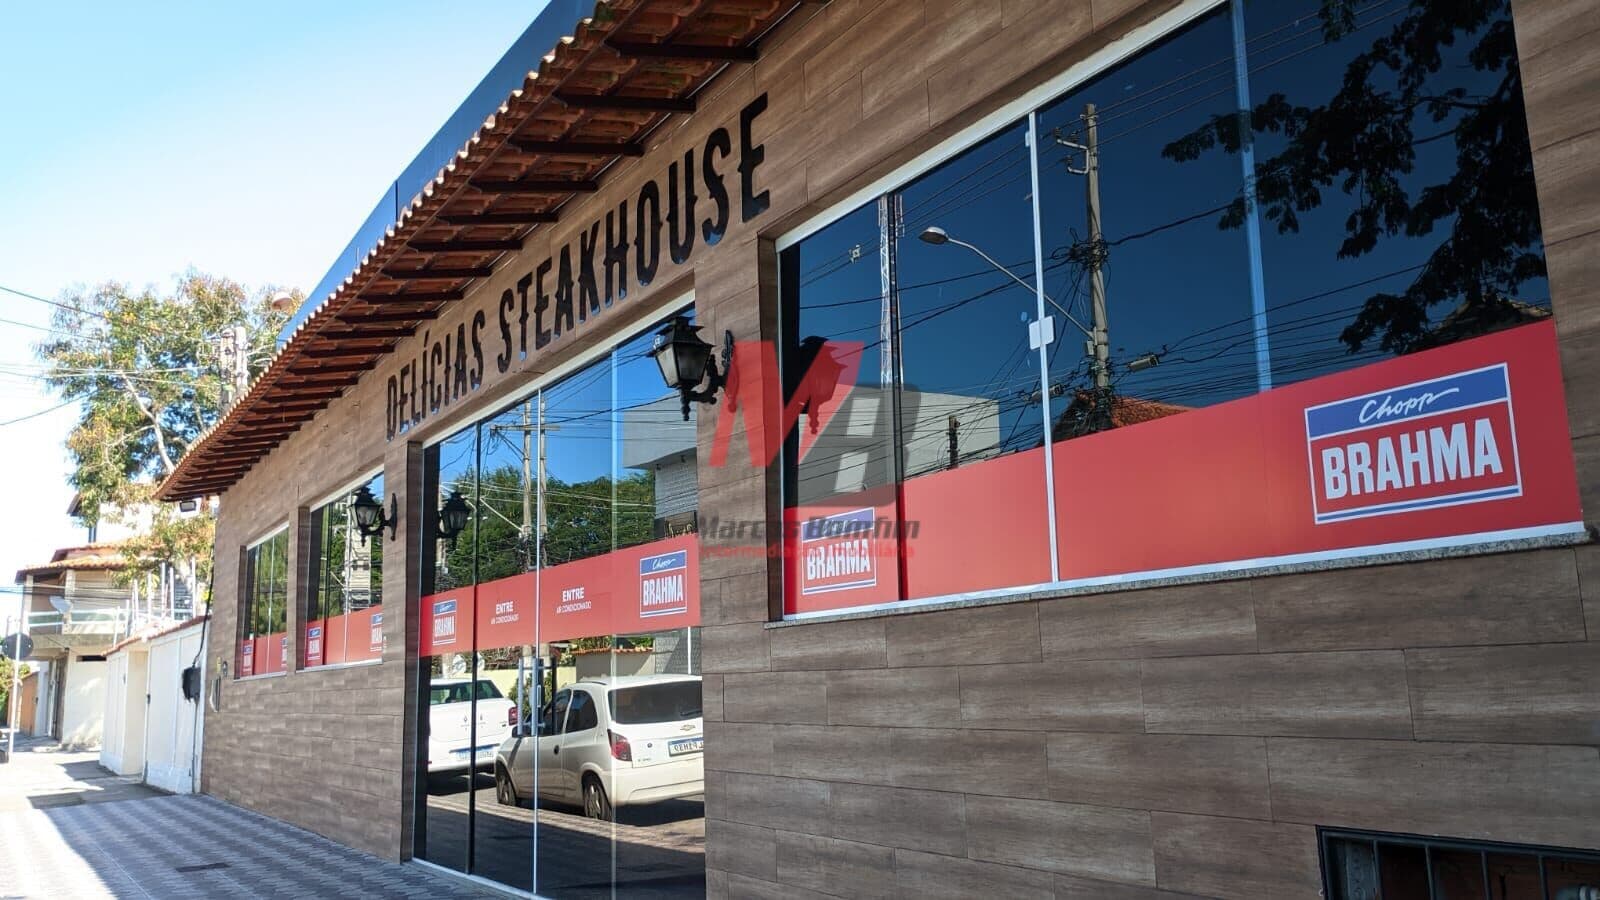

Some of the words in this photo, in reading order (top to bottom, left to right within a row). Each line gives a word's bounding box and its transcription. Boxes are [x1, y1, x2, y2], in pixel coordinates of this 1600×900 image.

[386, 310, 486, 442] DELÍCIAS
[497, 92, 771, 374] STEAKHOUSE
[1358, 387, 1460, 424] Chopp
[1321, 417, 1504, 501] BRAHMA
[806, 538, 871, 581] BRAHMA
[495, 600, 514, 615] ENTRE
[562, 587, 585, 602] ENTRE
[643, 574, 684, 607] BRAHMA
